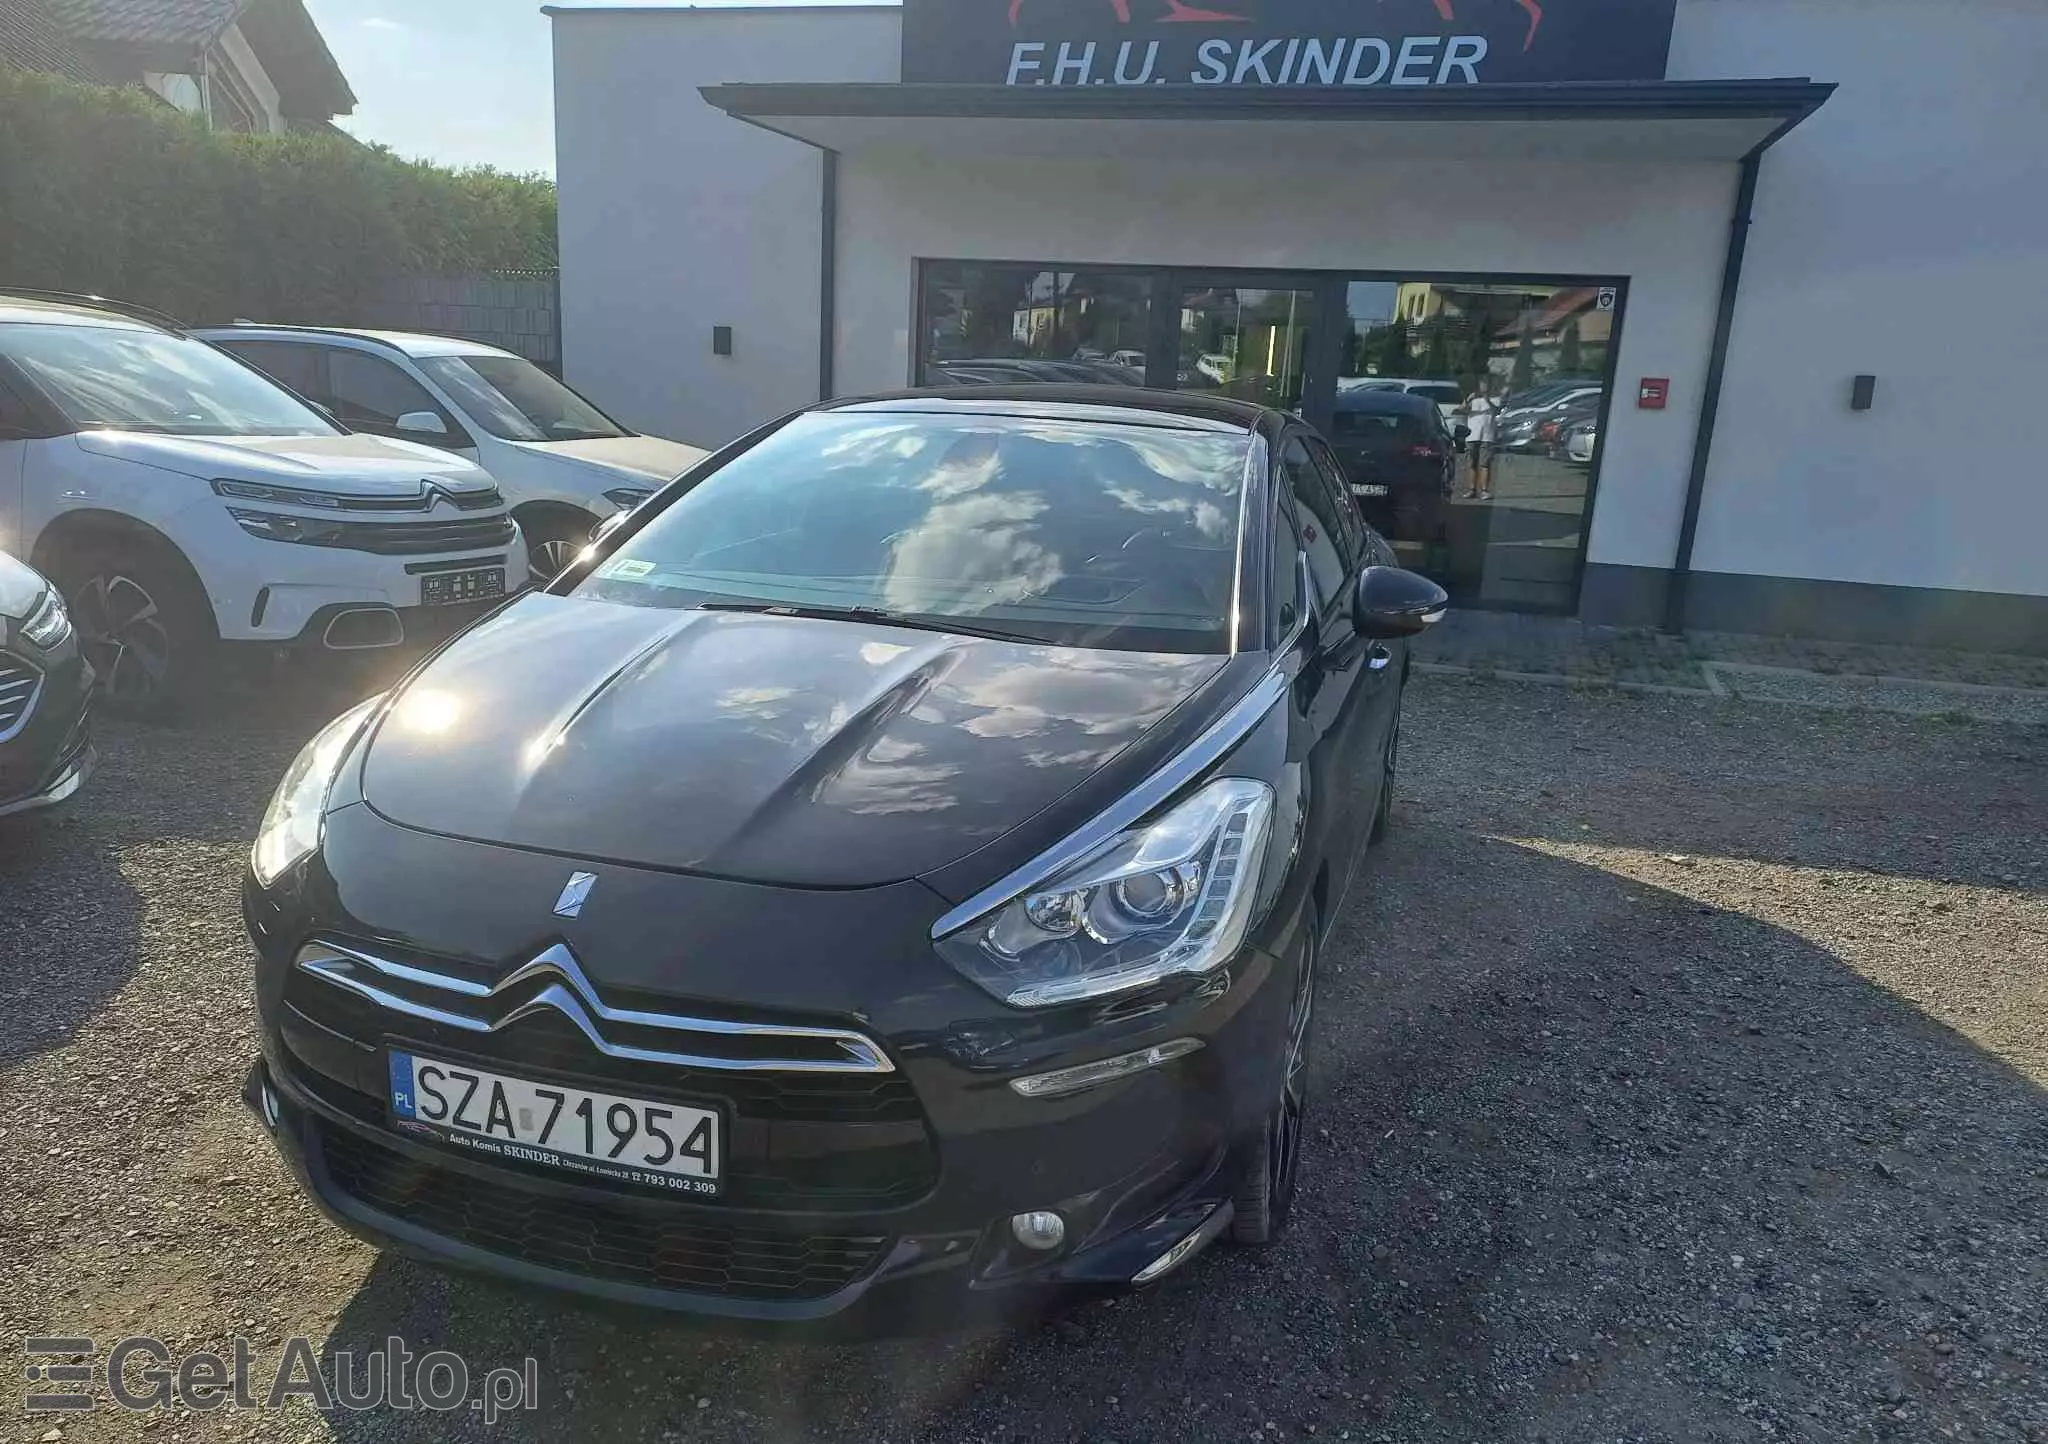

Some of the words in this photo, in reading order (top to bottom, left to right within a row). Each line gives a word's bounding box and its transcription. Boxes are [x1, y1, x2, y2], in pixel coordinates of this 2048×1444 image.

[1006, 41, 1166, 85] F.H.U.
[1191, 35, 1488, 85] SKINDER
[395, 1092, 413, 1109] PL
[418, 1065, 516, 1139] SZA
[535, 1088, 712, 1175] 71954
[449, 1133, 470, 1146] Auto
[472, 1138, 501, 1153] Komis
[503, 1144, 561, 1167] SKINDER
[643, 1173, 666, 1186] 793
[668, 1177, 691, 1190] 002
[693, 1181, 717, 1194] 309
